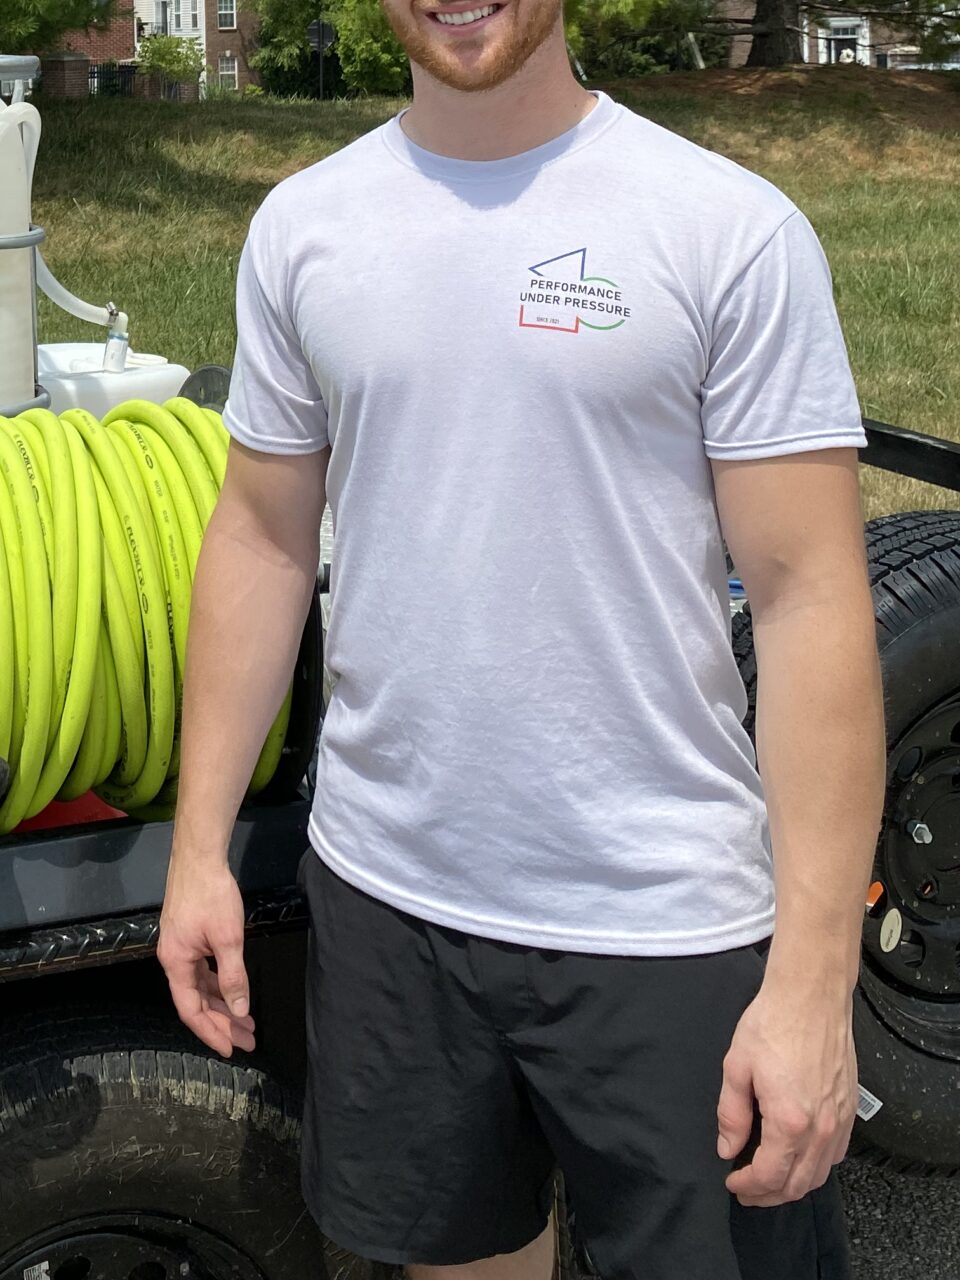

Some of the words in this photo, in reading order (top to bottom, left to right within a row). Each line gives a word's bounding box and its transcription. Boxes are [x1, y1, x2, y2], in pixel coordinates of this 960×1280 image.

[530, 279, 622, 301] PERFORMANCE
[520, 292, 560, 305] UNDER
[564, 297, 631, 317] PRESSURE
[126, 526, 145, 586] FLEXZILLA
